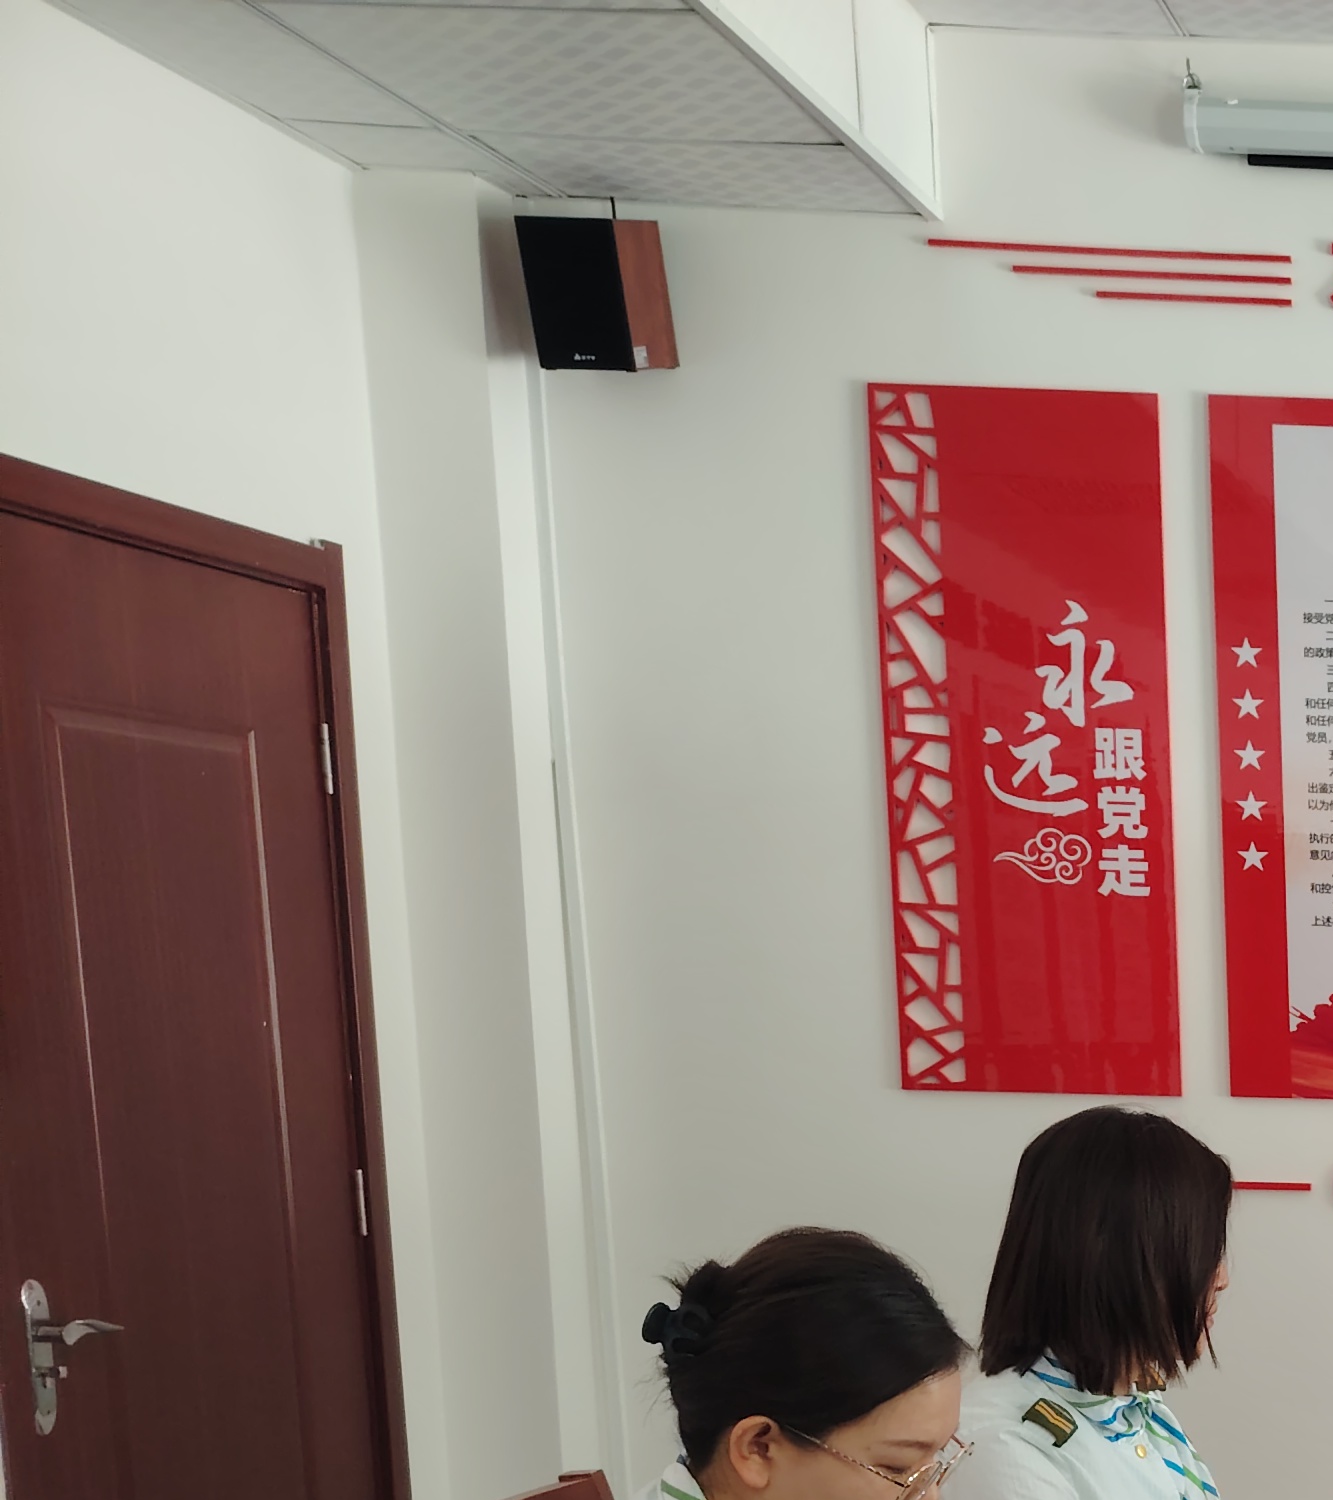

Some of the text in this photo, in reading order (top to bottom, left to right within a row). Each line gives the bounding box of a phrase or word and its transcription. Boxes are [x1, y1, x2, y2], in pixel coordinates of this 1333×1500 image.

[982, 600, 1134, 816] 永远
[1093, 727, 1150, 897] 跟党走
